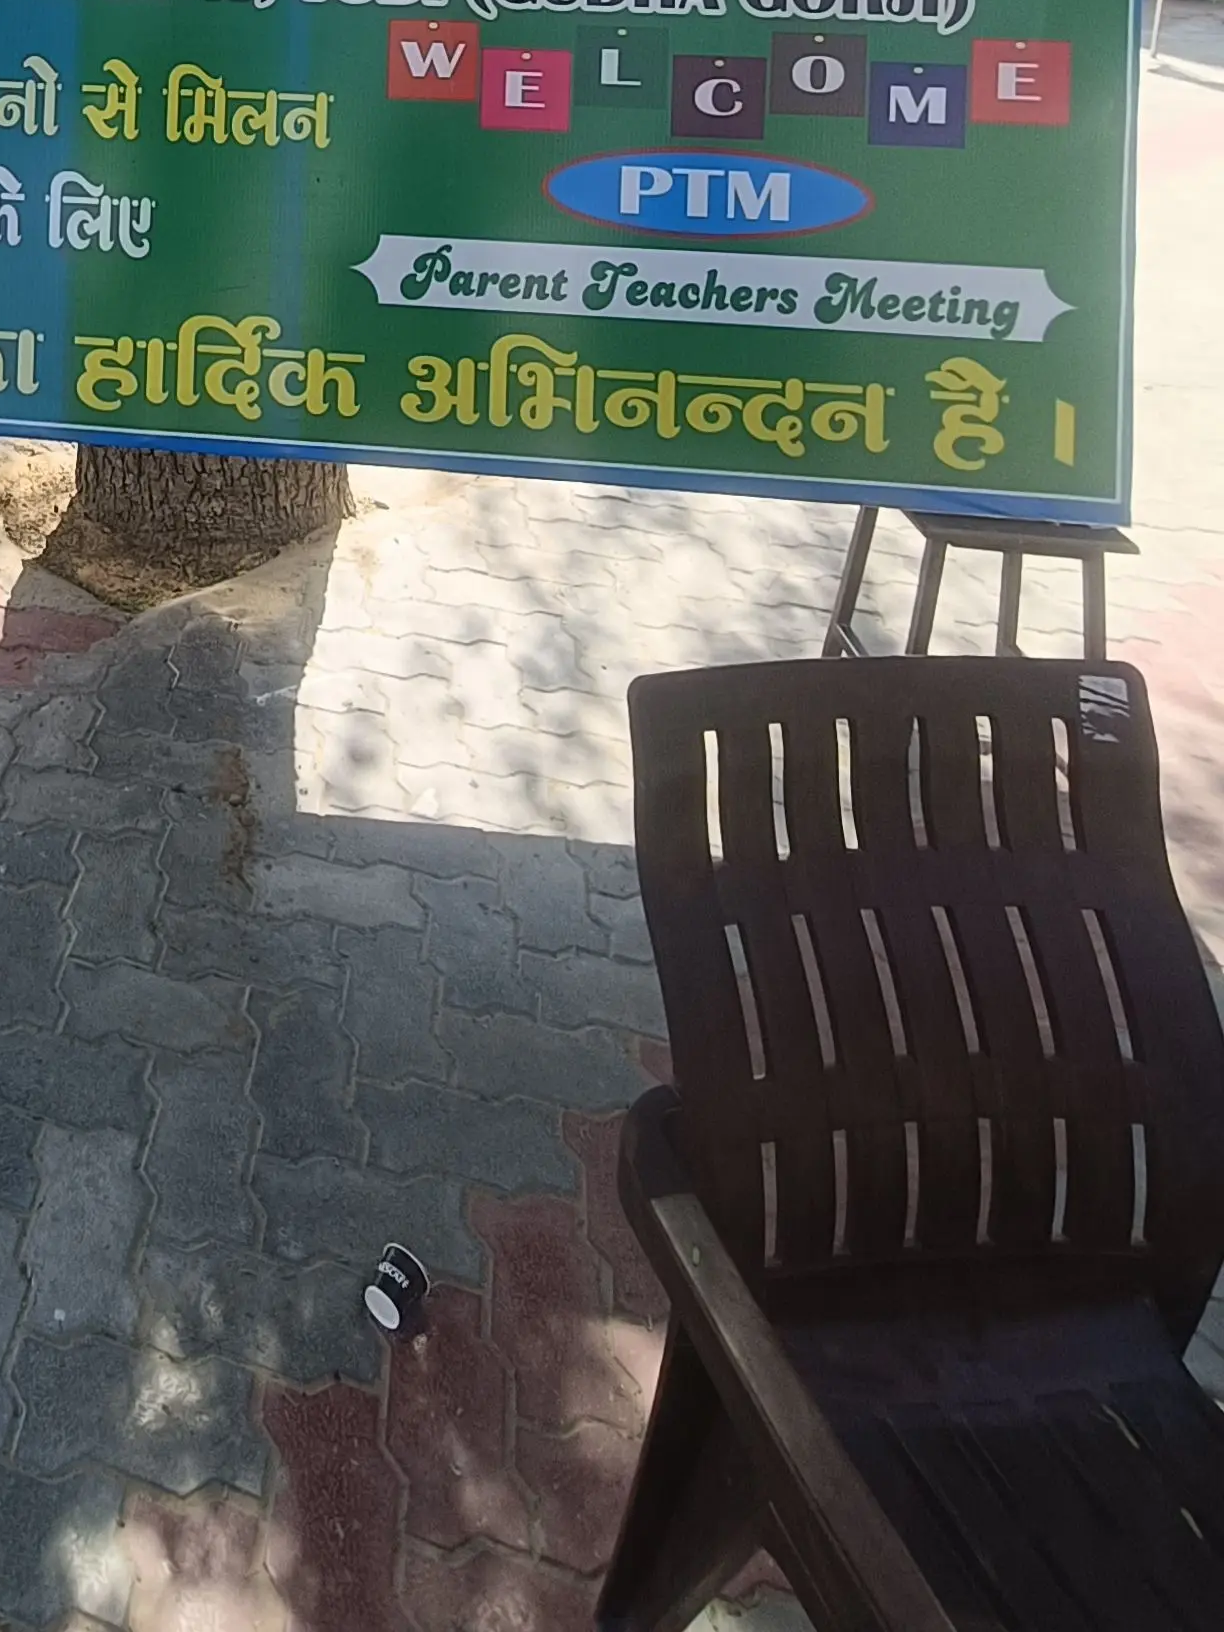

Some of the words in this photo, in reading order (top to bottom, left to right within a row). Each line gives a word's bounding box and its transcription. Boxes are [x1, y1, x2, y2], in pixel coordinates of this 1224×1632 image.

[81, 58, 143, 141] से
[162, 63, 334, 149] मिलन
[44, 170, 157, 259] लिए
[618, 164, 792, 222] PTM
[399, 244, 569, 301] Parent
[581, 260, 799, 316] Teachers
[813, 270, 1021, 340] Meeting
[74, 315, 368, 422] हार्दिक
[399, 334, 896, 457] अभिनन्दन
[925, 356, 1010, 471] है
